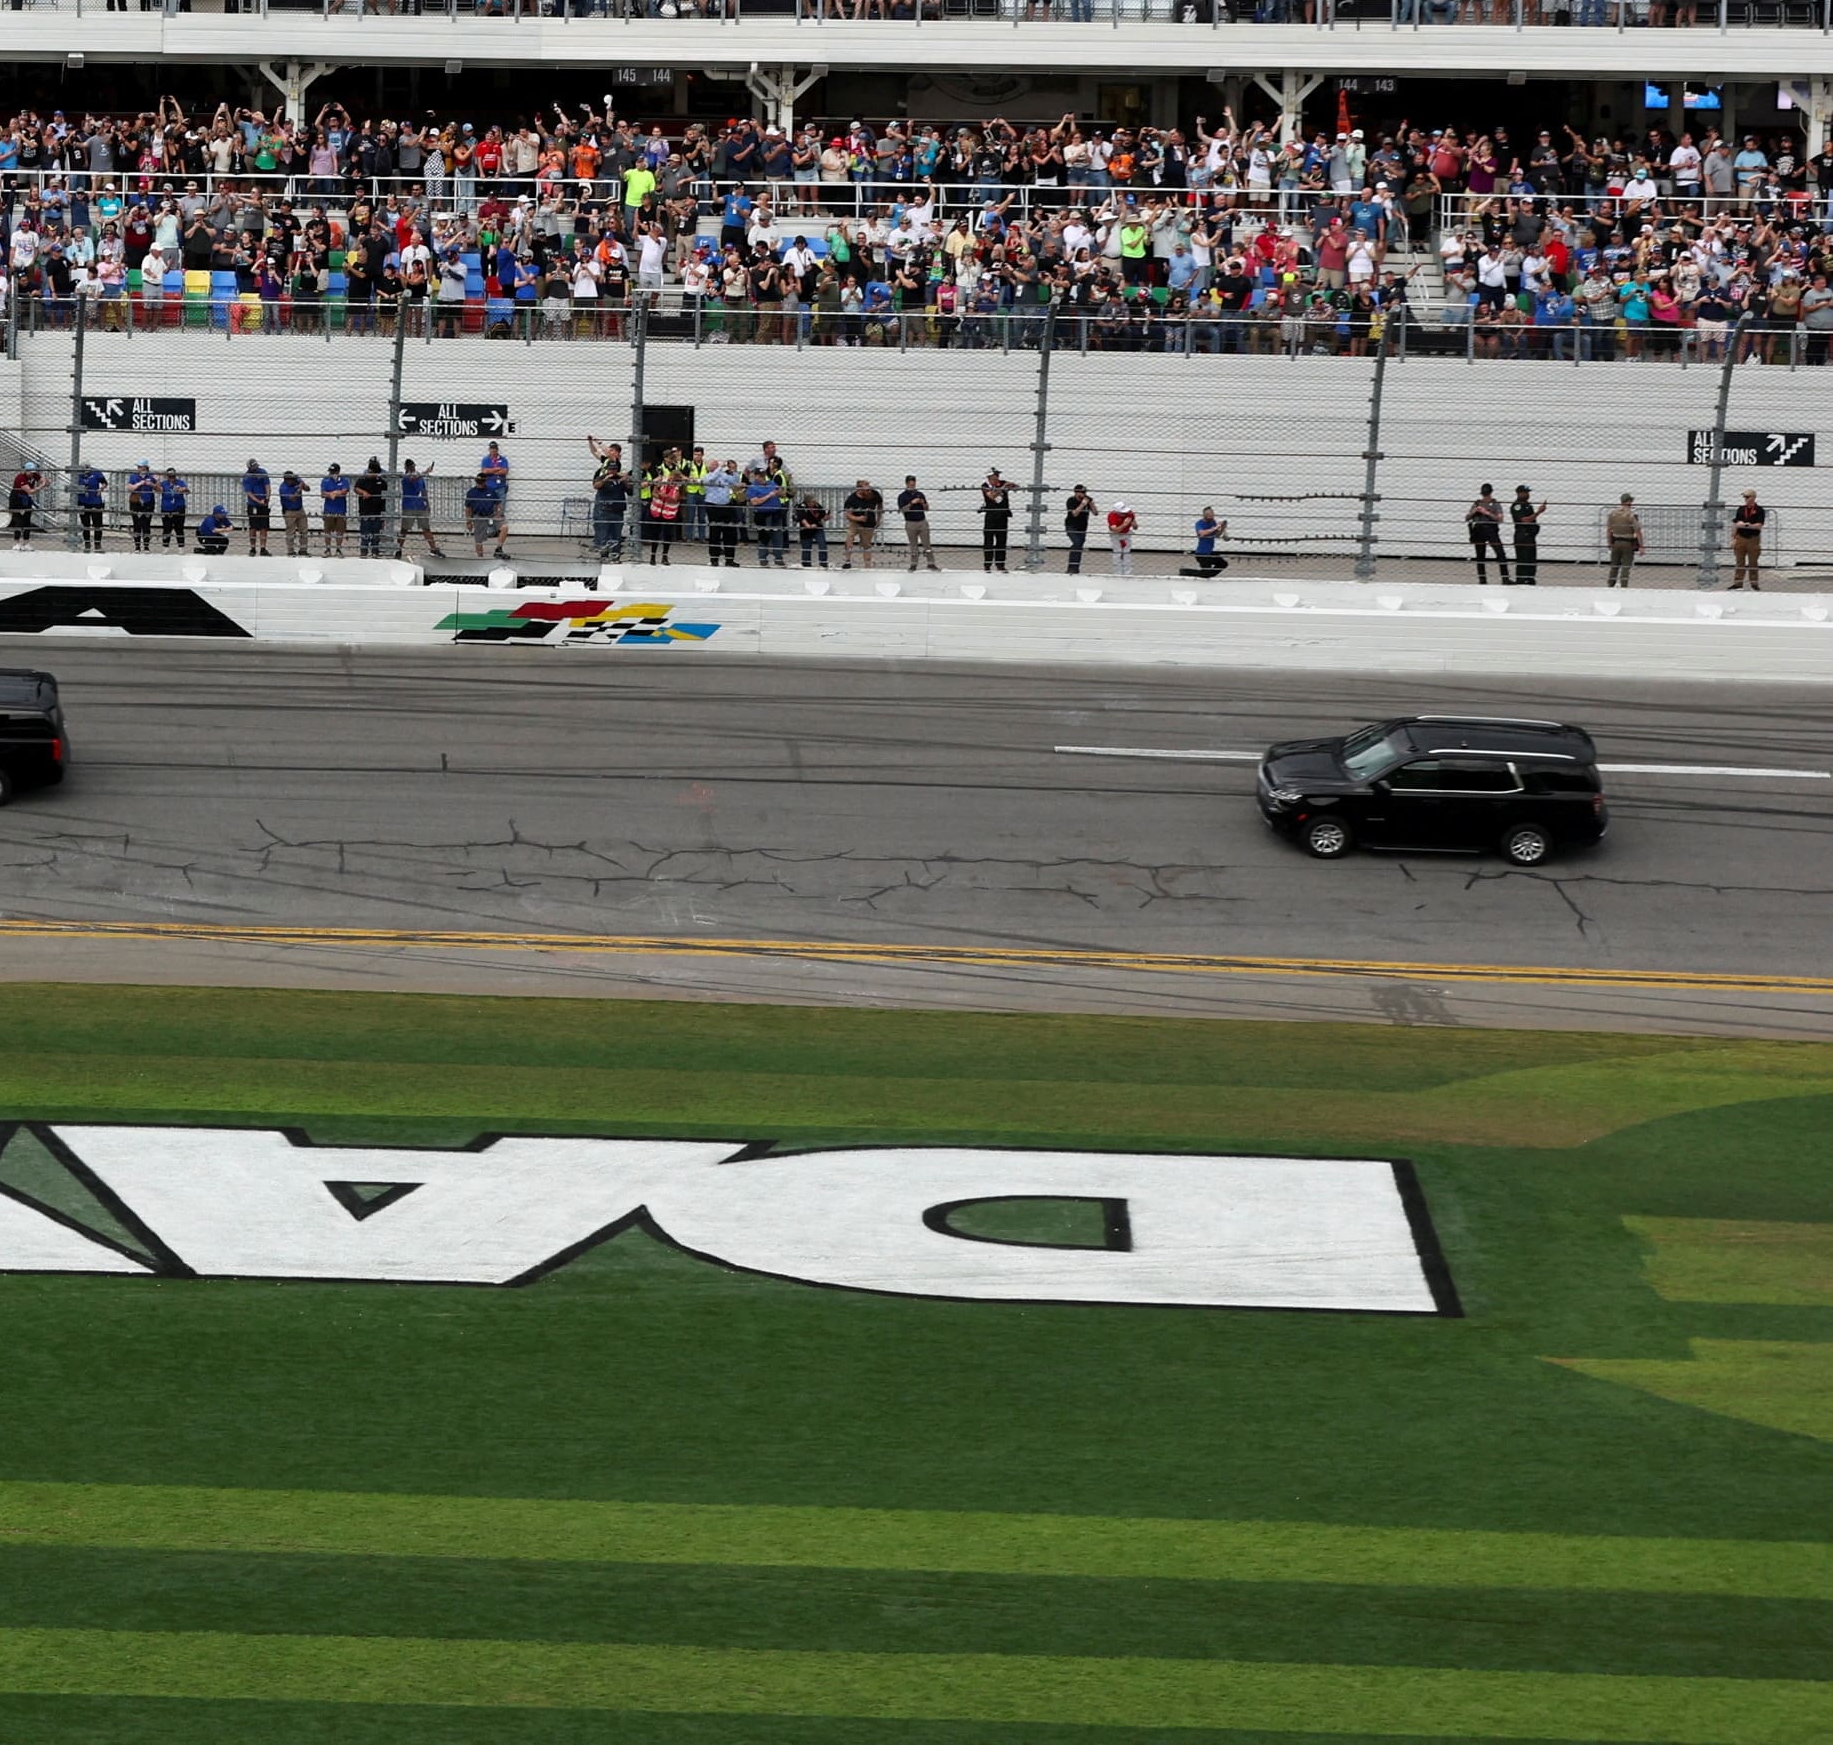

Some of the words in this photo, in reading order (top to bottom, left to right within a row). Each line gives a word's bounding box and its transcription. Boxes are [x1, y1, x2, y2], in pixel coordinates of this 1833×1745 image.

[618, 68, 636, 82] 145
[653, 68, 670, 82] 144
[1339, 78, 1357, 91] 144
[1375, 79, 1394, 91] 143
[133, 398, 154, 414] ALL
[438, 405, 459, 420] ALL
[132, 414, 190, 430] SECTIONS
[419, 420, 478, 436] SECTIONS
[508, 422, 516, 434] E
[1693, 448, 1758, 465] SECIONS
